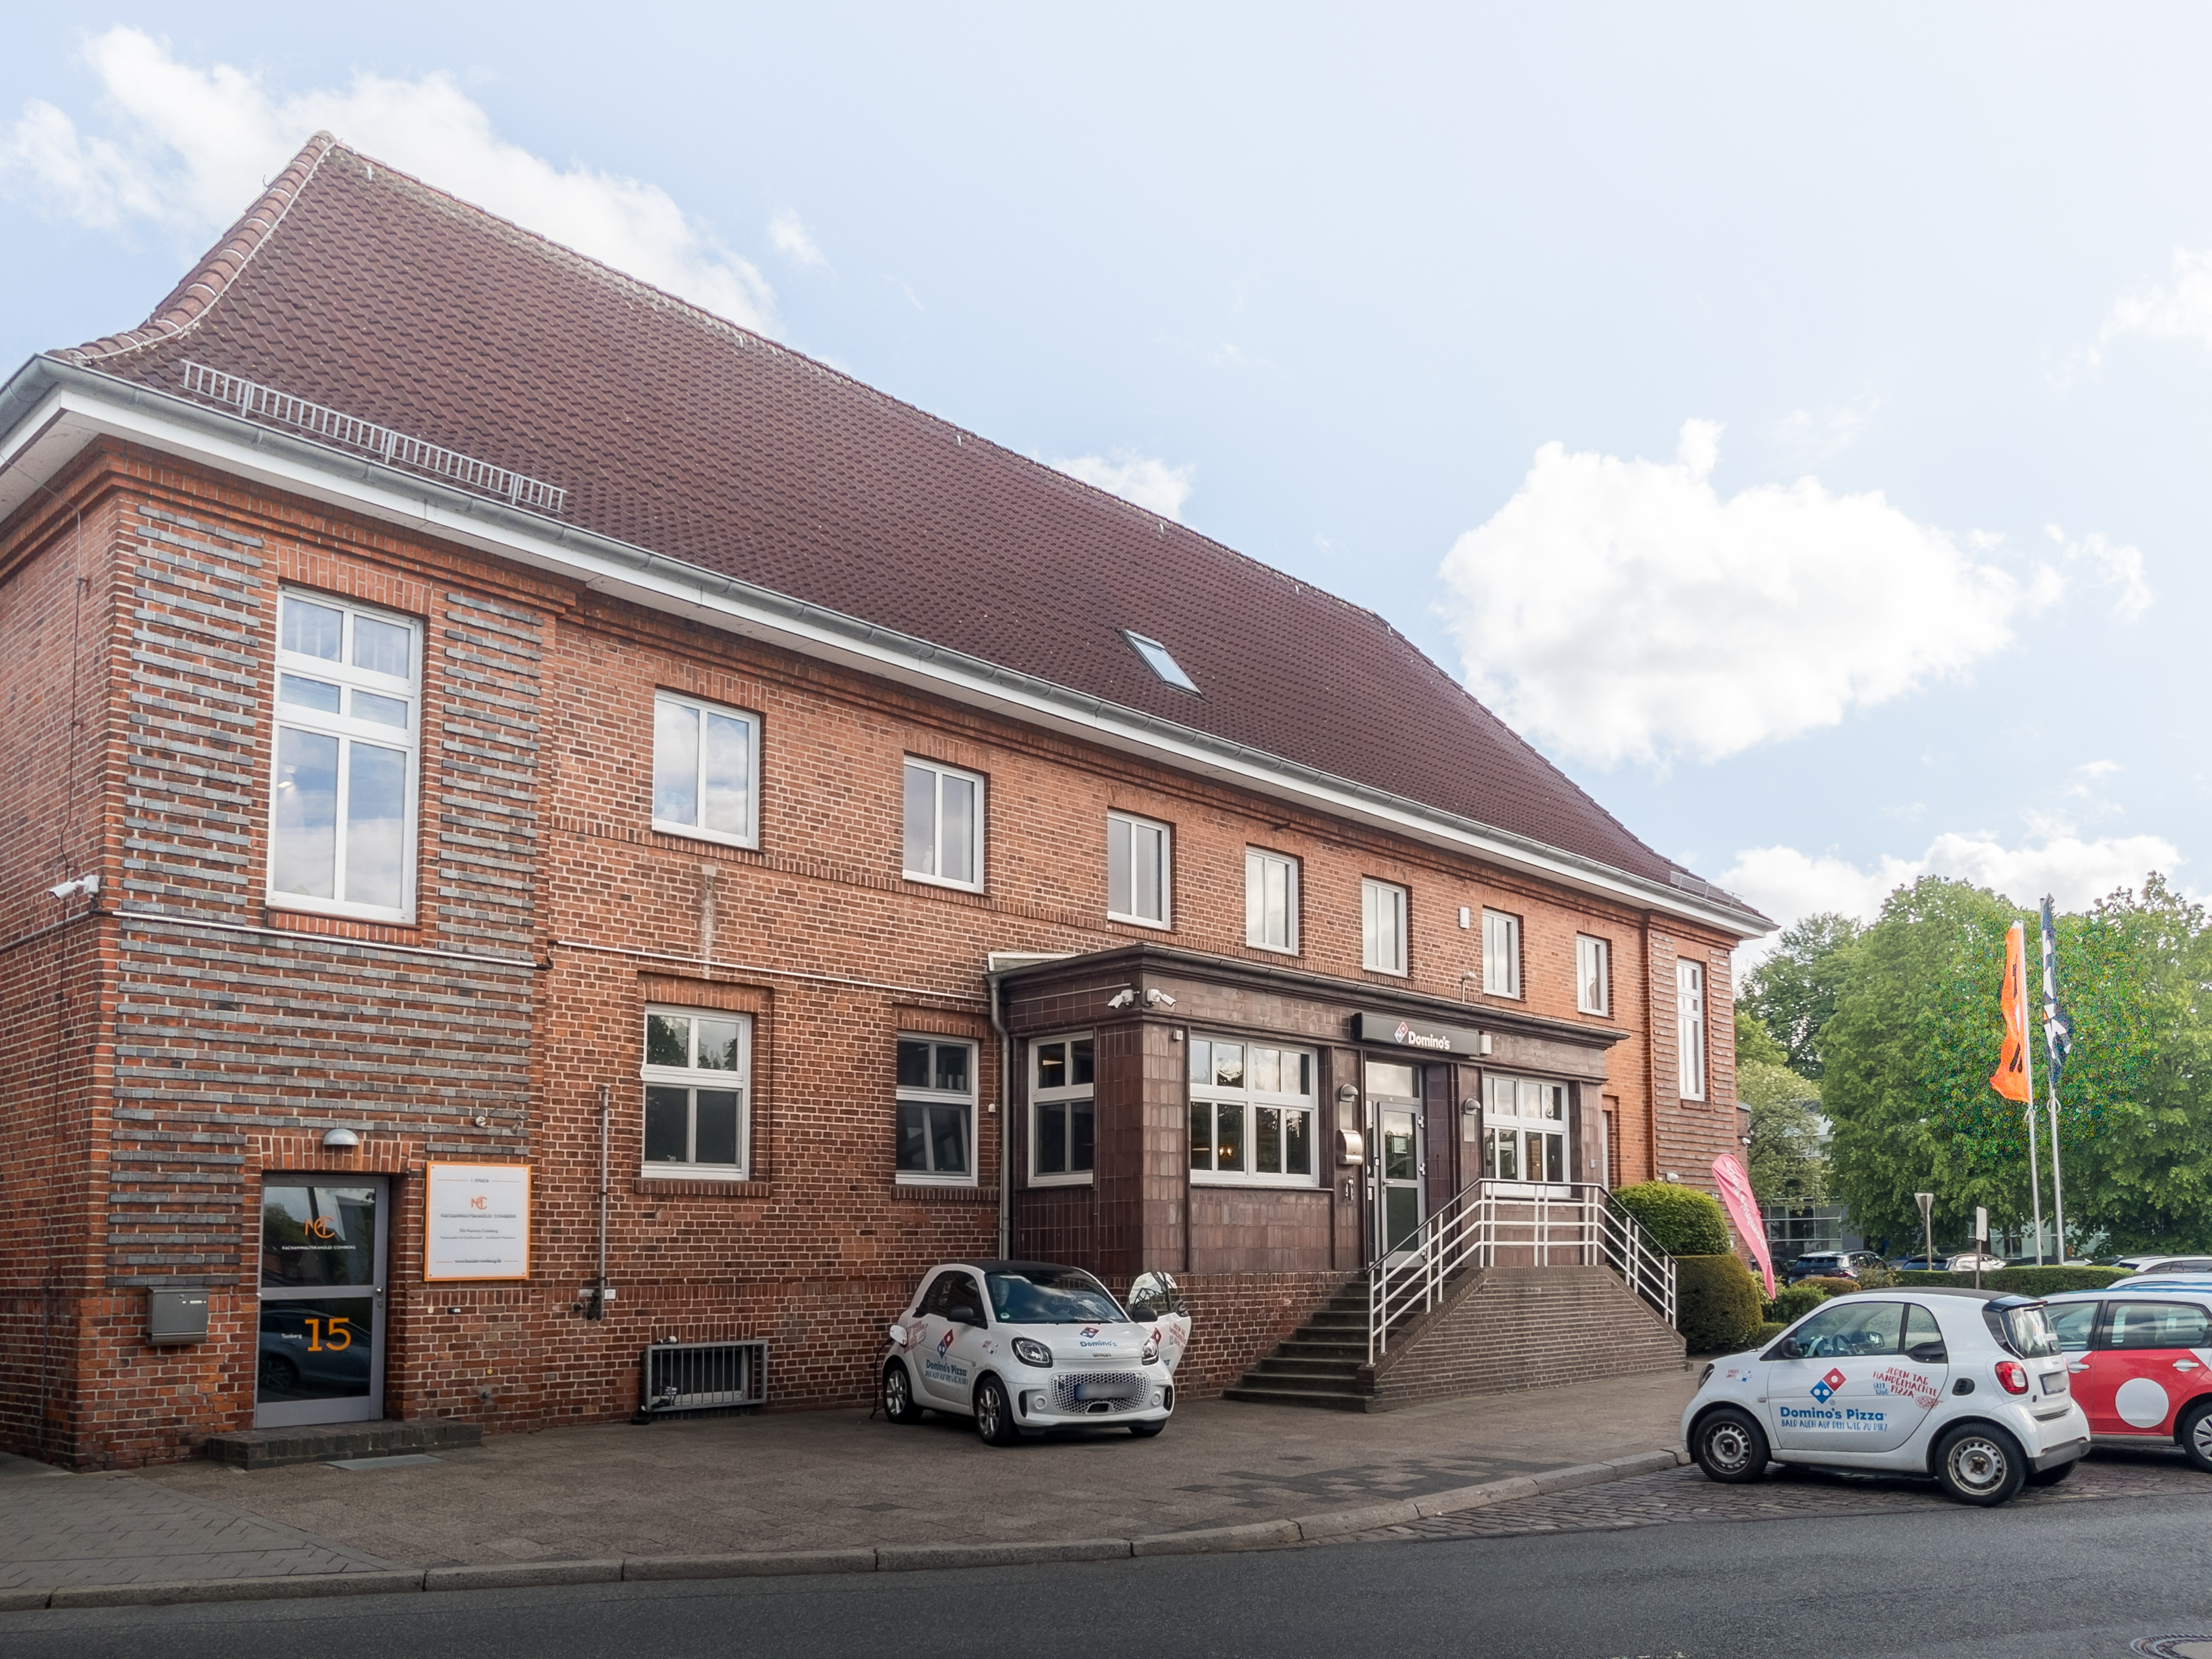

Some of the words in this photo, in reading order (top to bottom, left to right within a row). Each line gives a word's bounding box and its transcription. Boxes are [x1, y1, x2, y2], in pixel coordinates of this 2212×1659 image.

[1408, 1031, 1451, 1051] Domino's
[305, 1318, 351, 1351] 15
[926, 1359, 950, 1373] Domino's
[951, 1364, 967, 1376] Pizza
[1886, 1367, 1910, 1378] JEDEN
[1913, 1374, 1928, 1385] TAG
[1873, 1371, 1937, 1396] HANDGEMACHTE
[1891, 1385, 1914, 1398] PIZZA
[1780, 1407, 1842, 1419] Domino's
[1846, 1409, 1884, 1421] Pizza
[1799, 1420, 1815, 1428] AUCH
[1818, 1421, 1830, 1429] AUF
[1832, 1421, 1844, 1430] DEM
[1847, 1422, 1860, 1430] WEG
[1863, 1423, 1871, 1431] ZU
